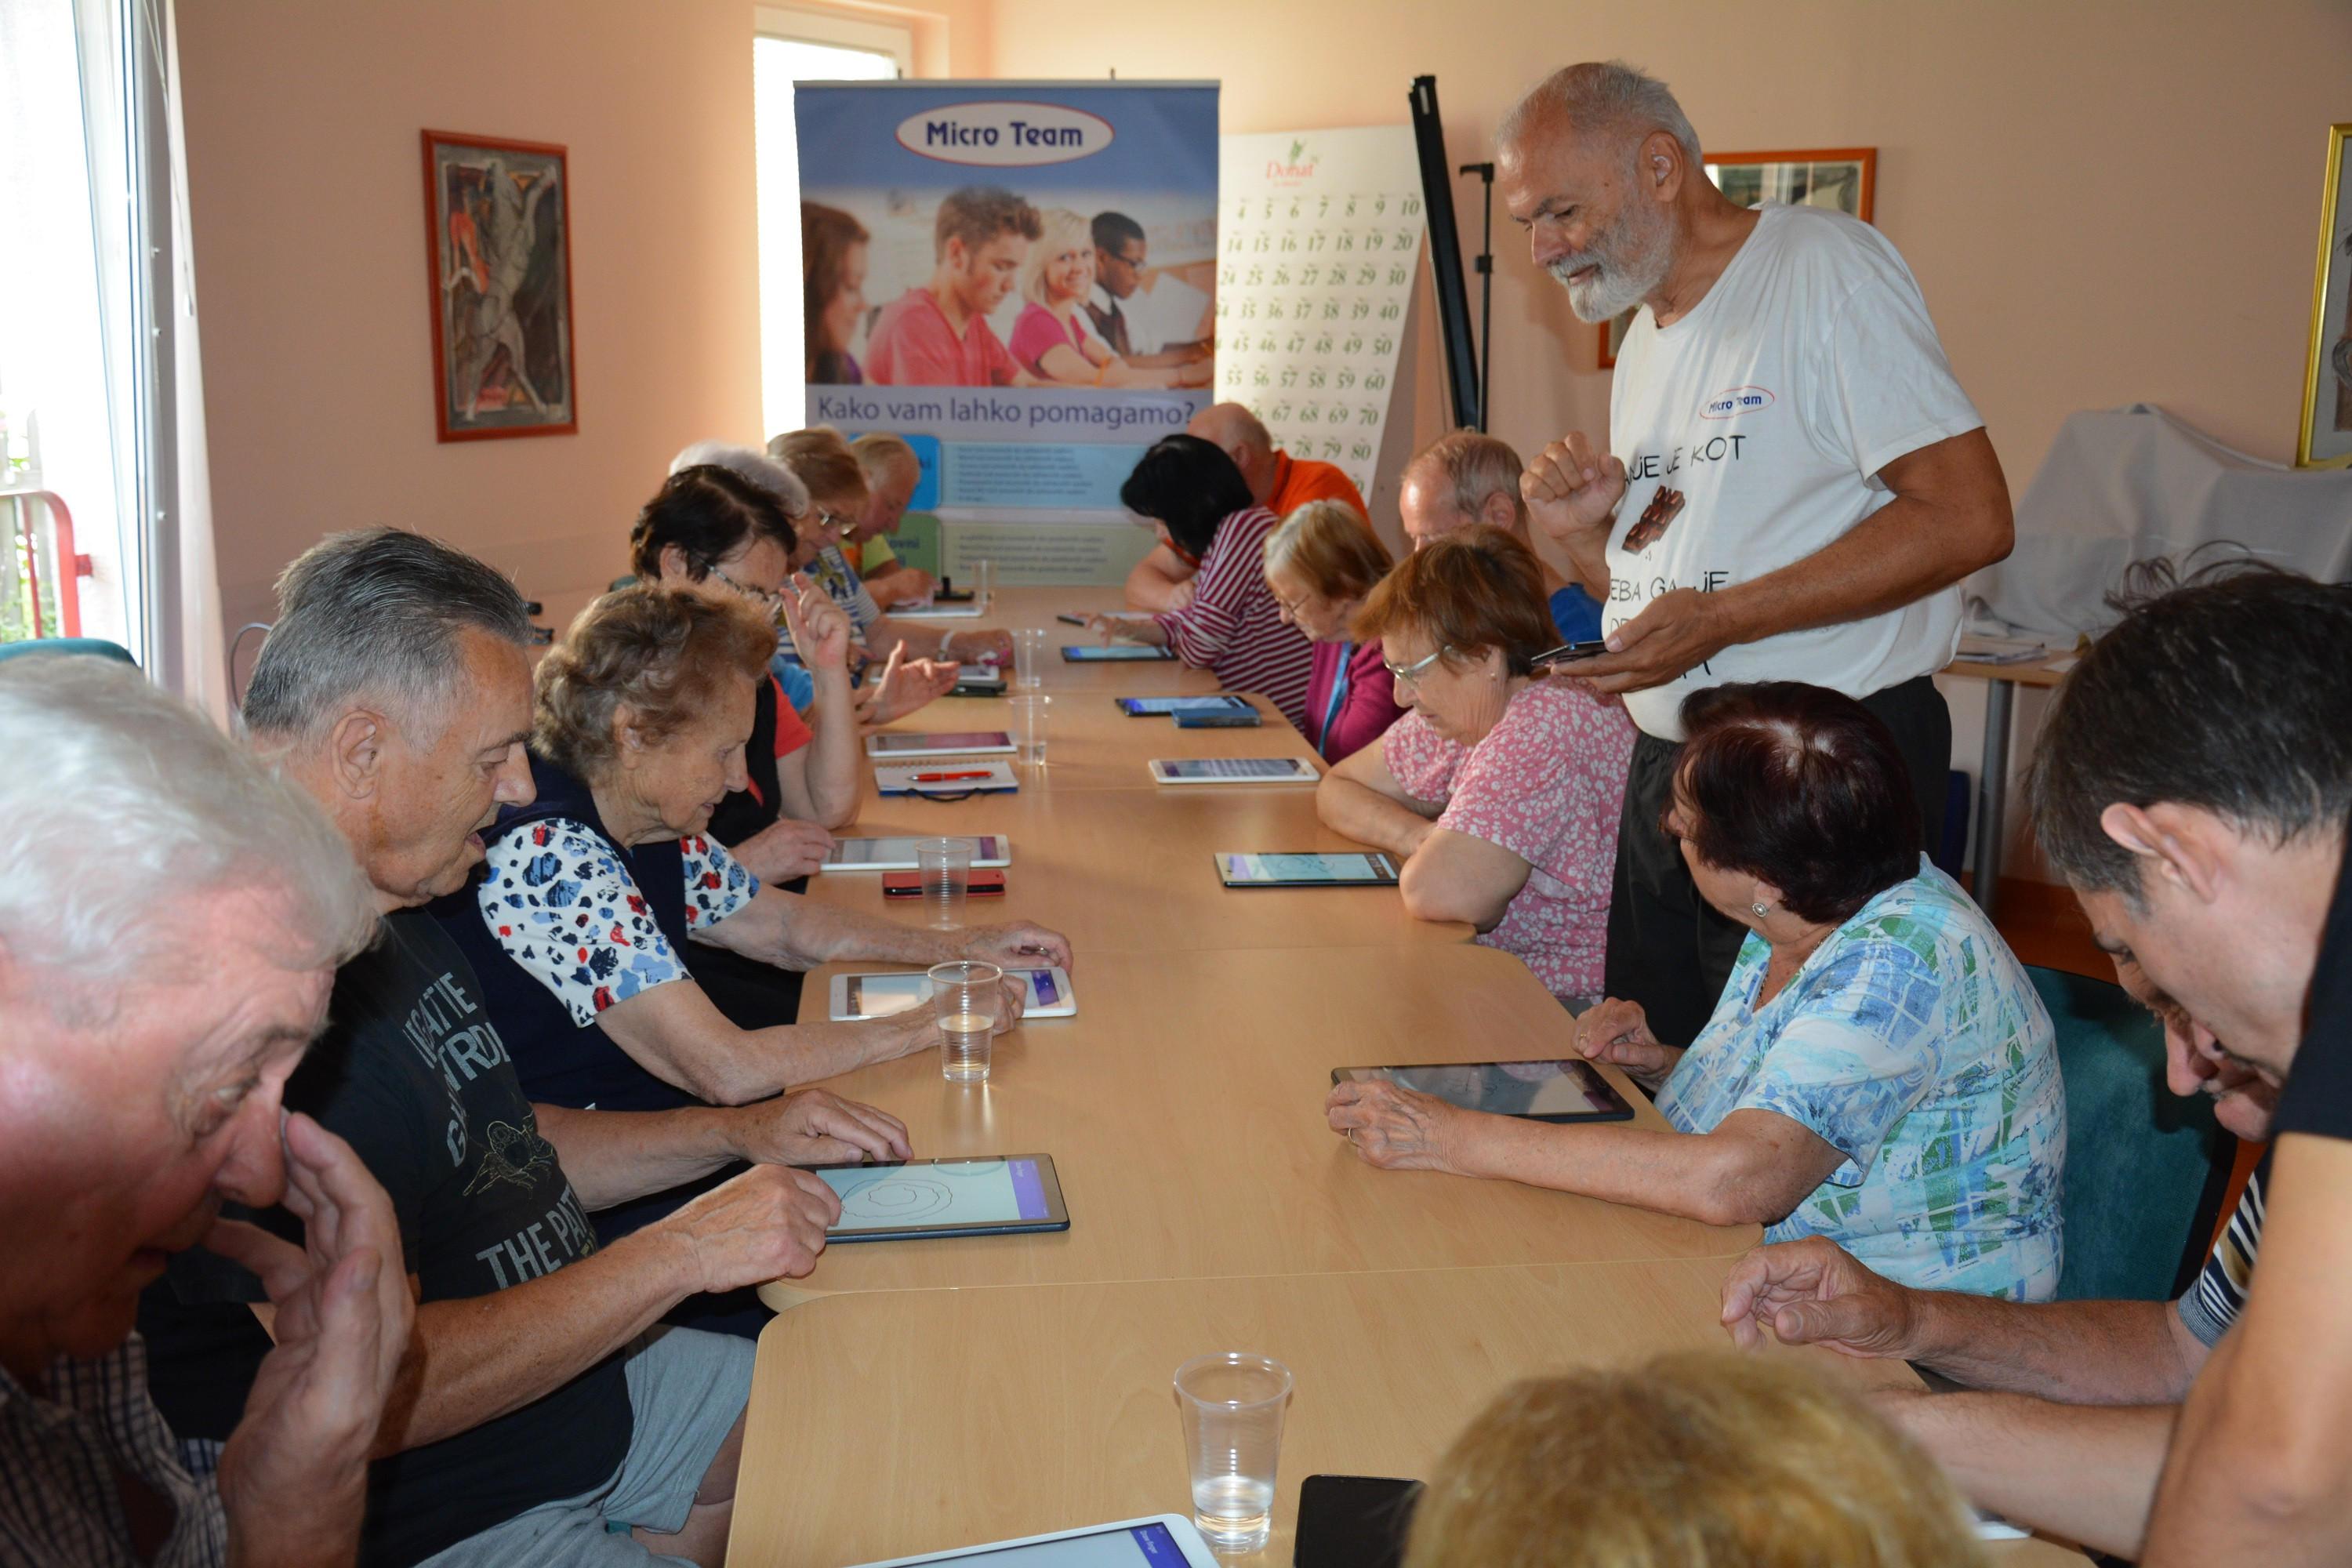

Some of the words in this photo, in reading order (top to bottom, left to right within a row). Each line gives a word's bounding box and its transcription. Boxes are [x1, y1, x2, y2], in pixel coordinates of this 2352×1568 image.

[926, 121, 999, 147] Micro
[1009, 121, 1083, 147] Team
[1290, 203, 1299, 218] 6
[1319, 201, 1330, 218] 7
[1345, 201, 1356, 217] 8
[1375, 200, 1386, 216] 9
[1402, 199, 1420, 216] 10
[1228, 237, 1243, 252] 14
[1254, 236, 1271, 252] 15
[1280, 236, 1298, 252] 16
[1308, 235, 1326, 252] 17
[1336, 235, 1354, 252] 18
[1365, 234, 1384, 251] 19
[1392, 234, 1413, 251] 20
[1221, 270, 1236, 285] 24
[1246, 270, 1263, 285] 25
[1272, 270, 1290, 285] 26
[1300, 269, 1319, 285] 27
[1327, 269, 1347, 285] 28
[1356, 269, 1377, 285] 29
[1387, 269, 1406, 285] 30
[1241, 303, 1256, 318] 35
[1268, 303, 1283, 319] 36
[1295, 303, 1312, 320] 37
[1323, 303, 1341, 320] 38
[1352, 303, 1370, 320] 39
[1380, 304, 1399, 321] 40
[1232, 336, 1250, 352] 45
[1259, 337, 1276, 352] 46
[1287, 337, 1305, 353] 47
[1314, 338, 1333, 354] 48
[1344, 338, 1363, 354] 49
[1373, 338, 1392, 355] 50
[1226, 369, 1243, 386] 55
[1253, 370, 1270, 386] 56
[1280, 371, 1298, 387] 57
[1308, 371, 1327, 388] 58
[1337, 372, 1356, 389] 59
[1365, 372, 1385, 390] 60
[818, 397, 879, 420] Kako
[886, 403, 942, 420] vam
[951, 398, 1020, 422] lahko
[1029, 403, 1194, 430] pomagamo?
[1272, 405, 1292, 422] 67
[1300, 406, 1319, 423] 68
[1329, 407, 1348, 423] 69
[1359, 408, 1378, 426] 70
[1708, 400, 1733, 414] Micro
[1294, 440, 1312, 457] 78
[1323, 441, 1342, 459] 79
[1352, 443, 1371, 461] 80
[1691, 435, 1746, 466] KOT
[475, 1221, 562, 1290] THE
